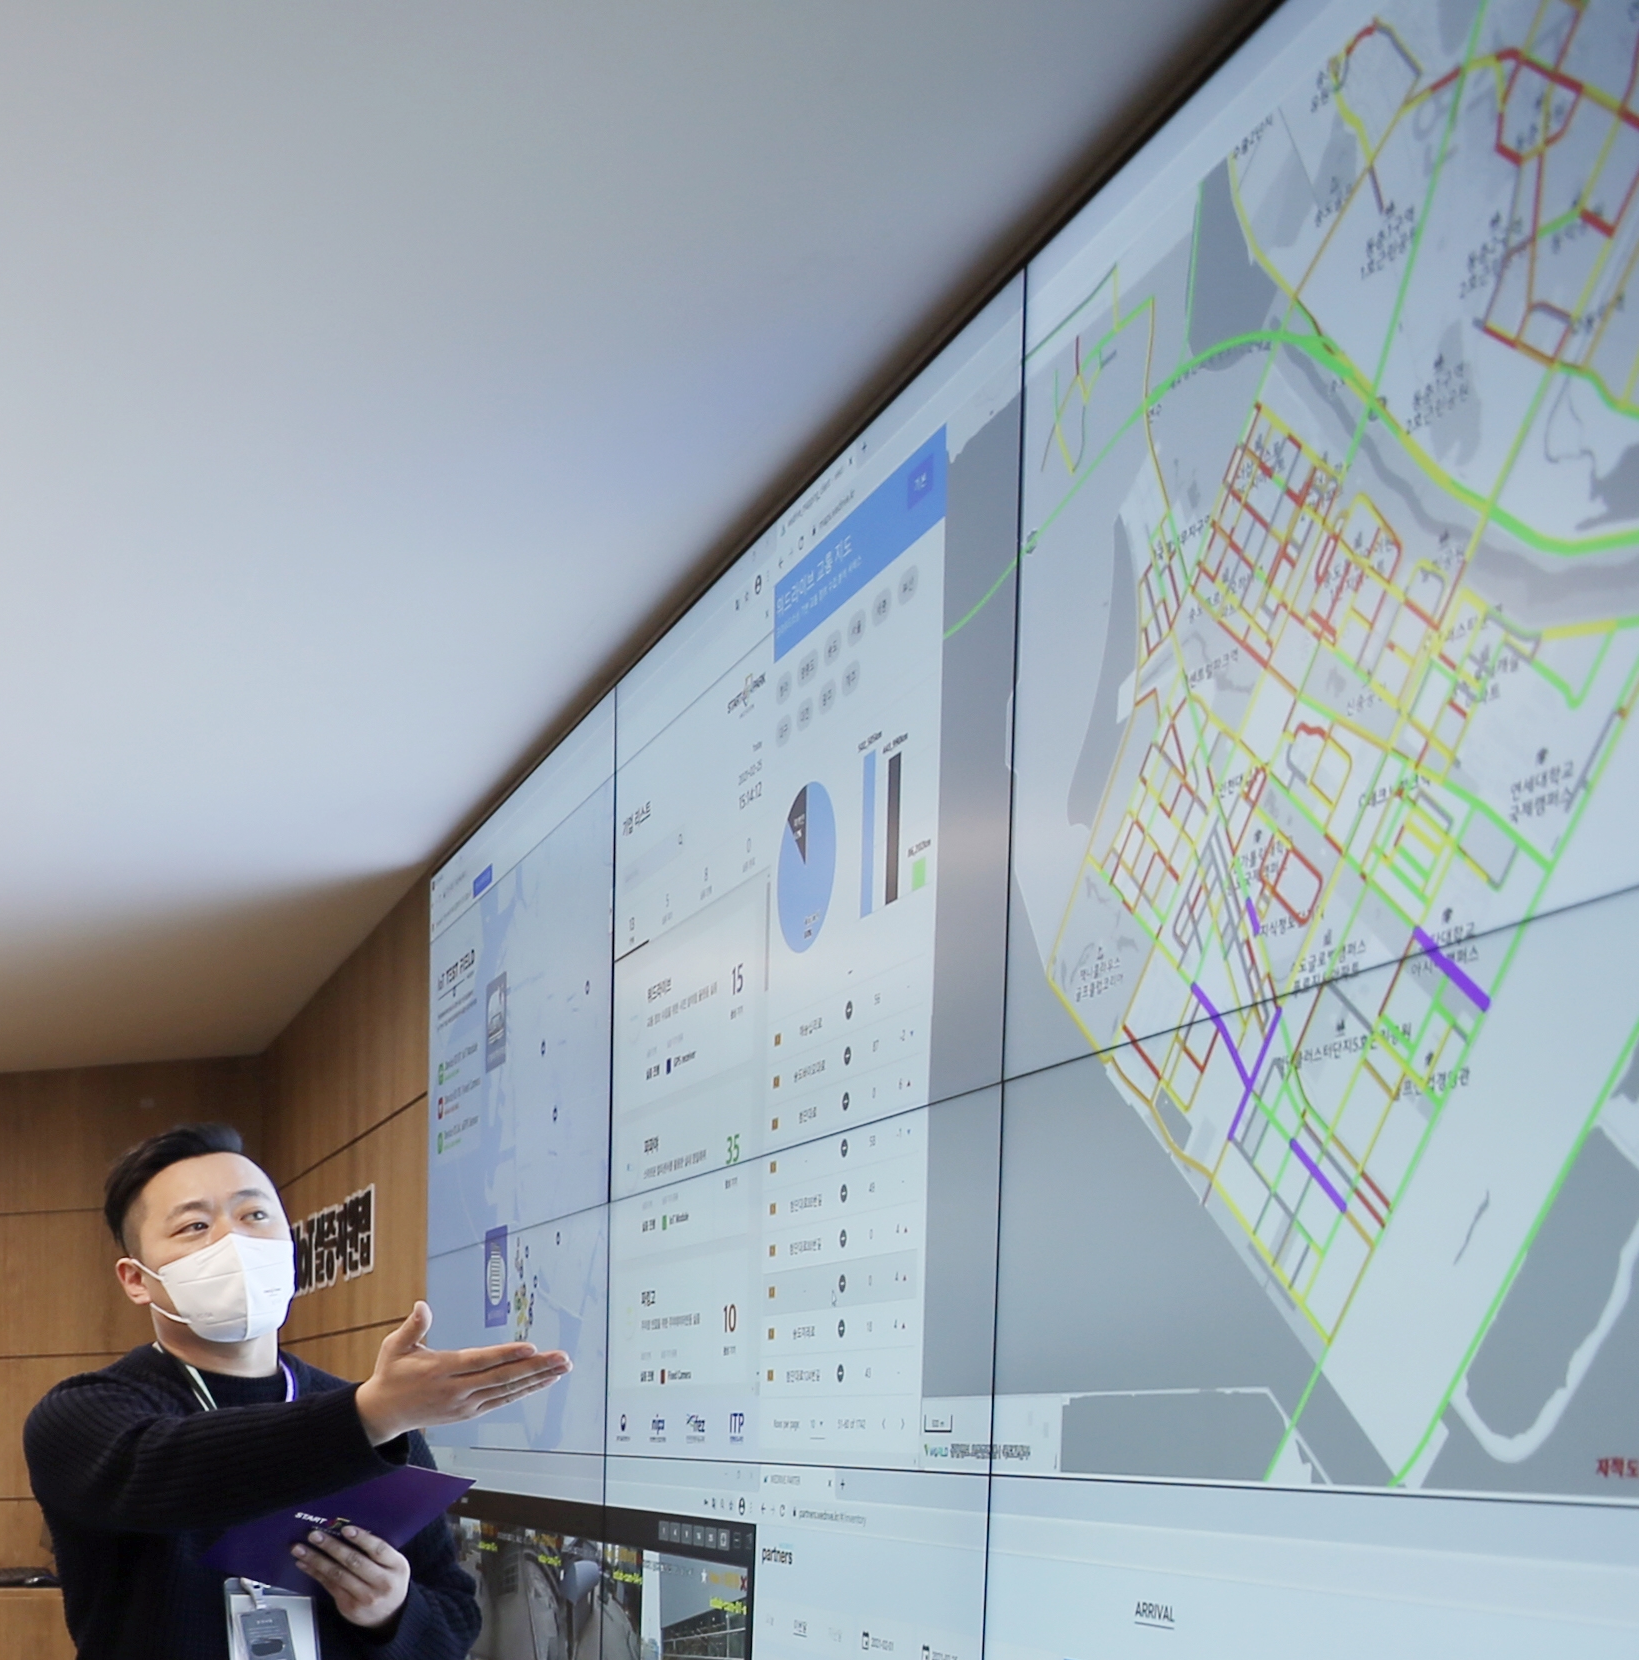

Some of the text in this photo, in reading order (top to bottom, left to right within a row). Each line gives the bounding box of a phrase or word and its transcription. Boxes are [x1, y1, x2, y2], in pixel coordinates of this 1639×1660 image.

[732, 963, 744, 996] 15
[725, 1133, 740, 1165] 35
[723, 1303, 737, 1333] 10
[729, 1412, 744, 1433] ITP
[761, 1547, 793, 1565] partners
[1134, 1599, 1176, 1624] ARRIVAL
